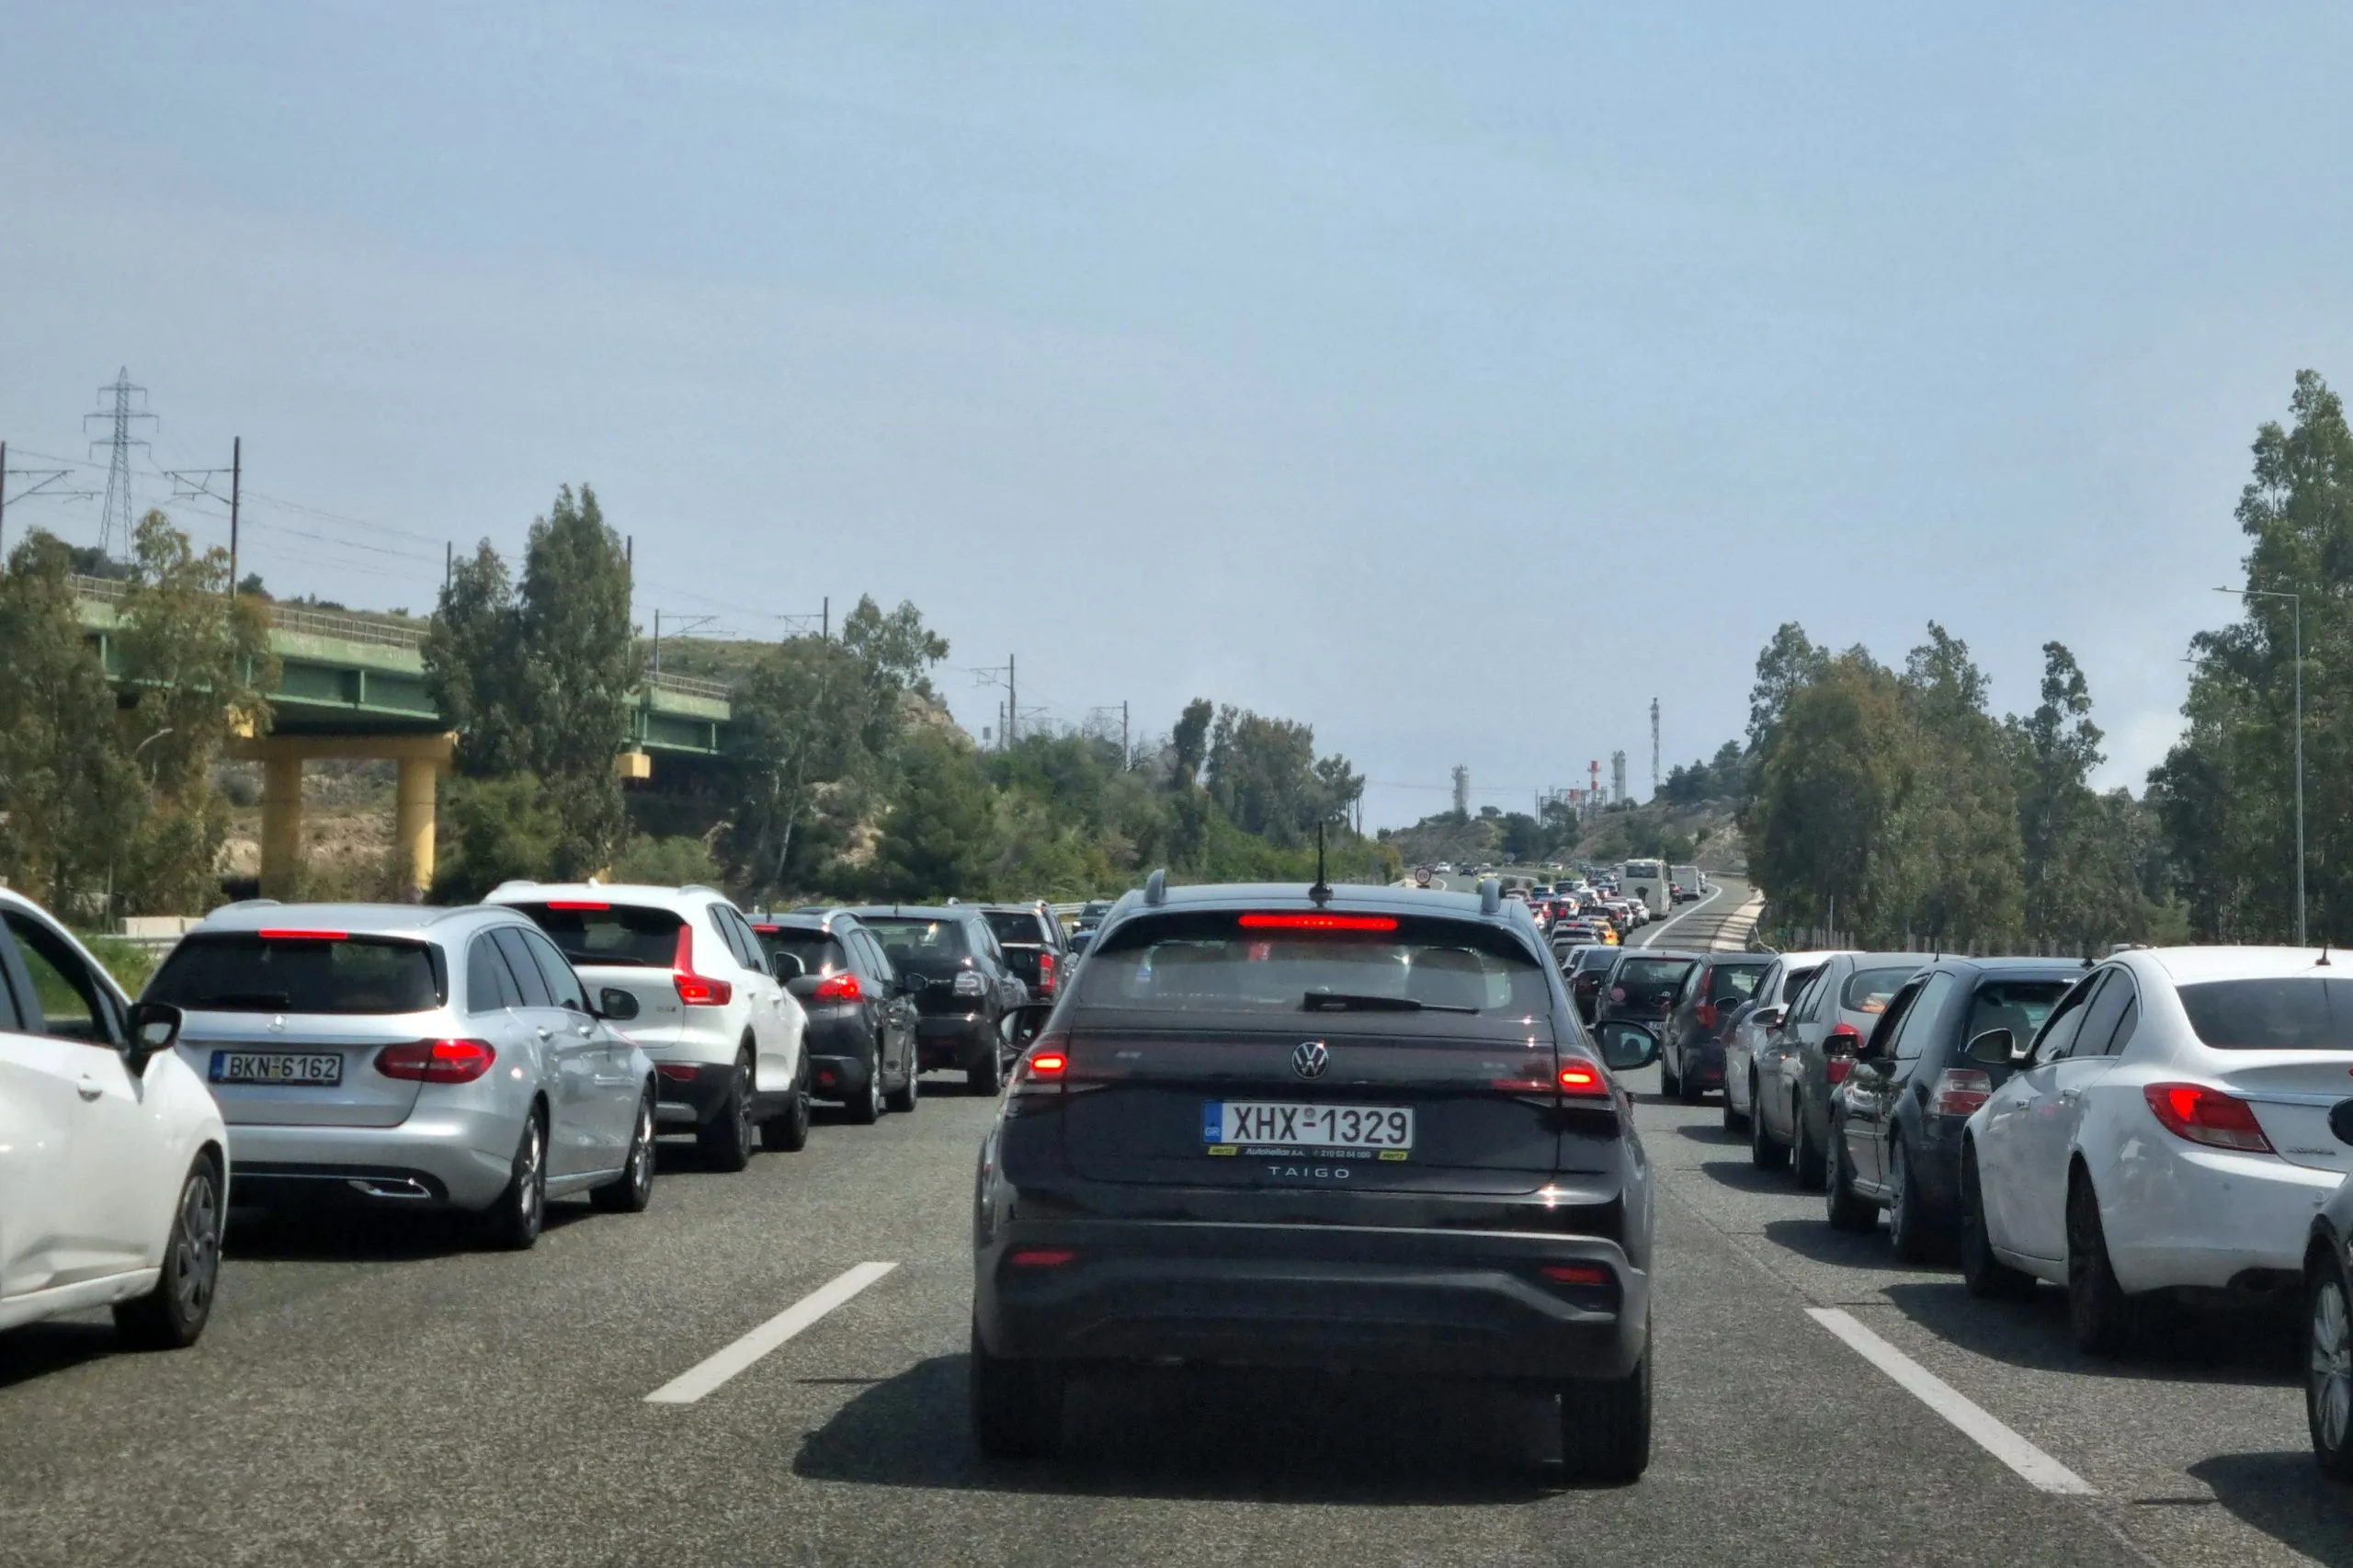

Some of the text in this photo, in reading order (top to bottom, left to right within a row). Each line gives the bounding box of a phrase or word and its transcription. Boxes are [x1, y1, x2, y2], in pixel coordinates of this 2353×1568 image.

[230, 1057, 337, 1079] BKN-6162
[1205, 1127, 1221, 1137] GR
[1233, 1106, 1407, 1144] XHX-1329
[1267, 1165, 1350, 1178] TAIGO
